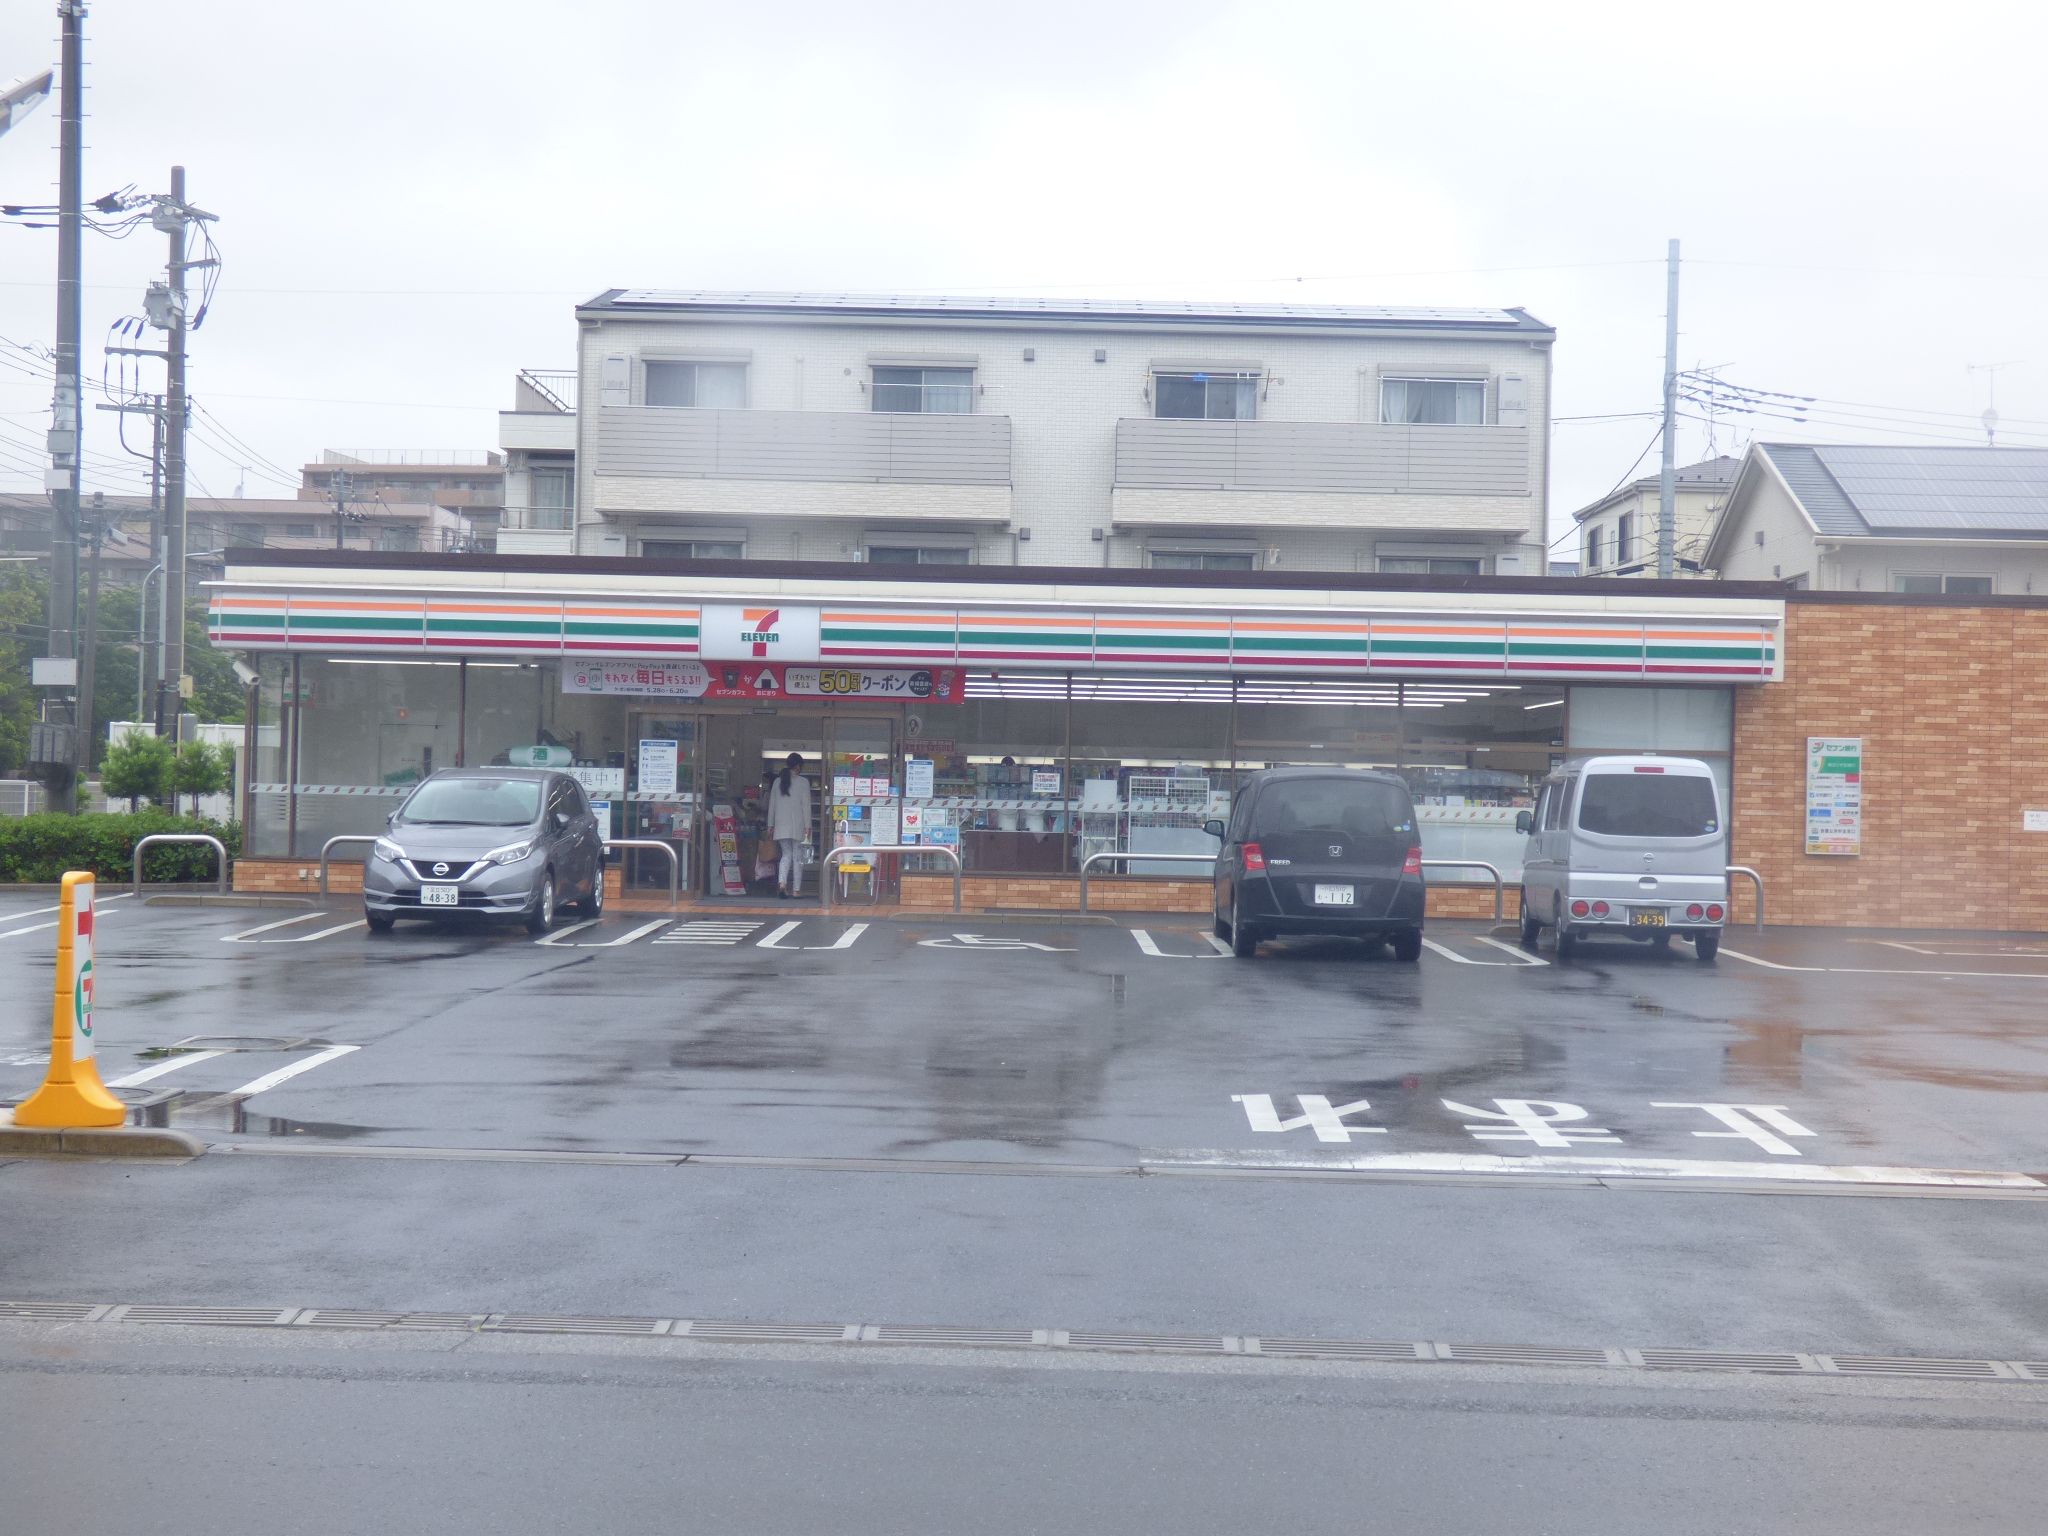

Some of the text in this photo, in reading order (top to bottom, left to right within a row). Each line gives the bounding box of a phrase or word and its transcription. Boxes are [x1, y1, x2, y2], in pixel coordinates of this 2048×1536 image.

[743, 609, 779, 657] 7
[743, 674, 753, 684] か
[1826, 744, 1858, 752] セブン銀行
[533, 748, 548, 761] 酒
[429, 893, 456, 904] 48-38
[1637, 914, 1665, 926] 34-39
